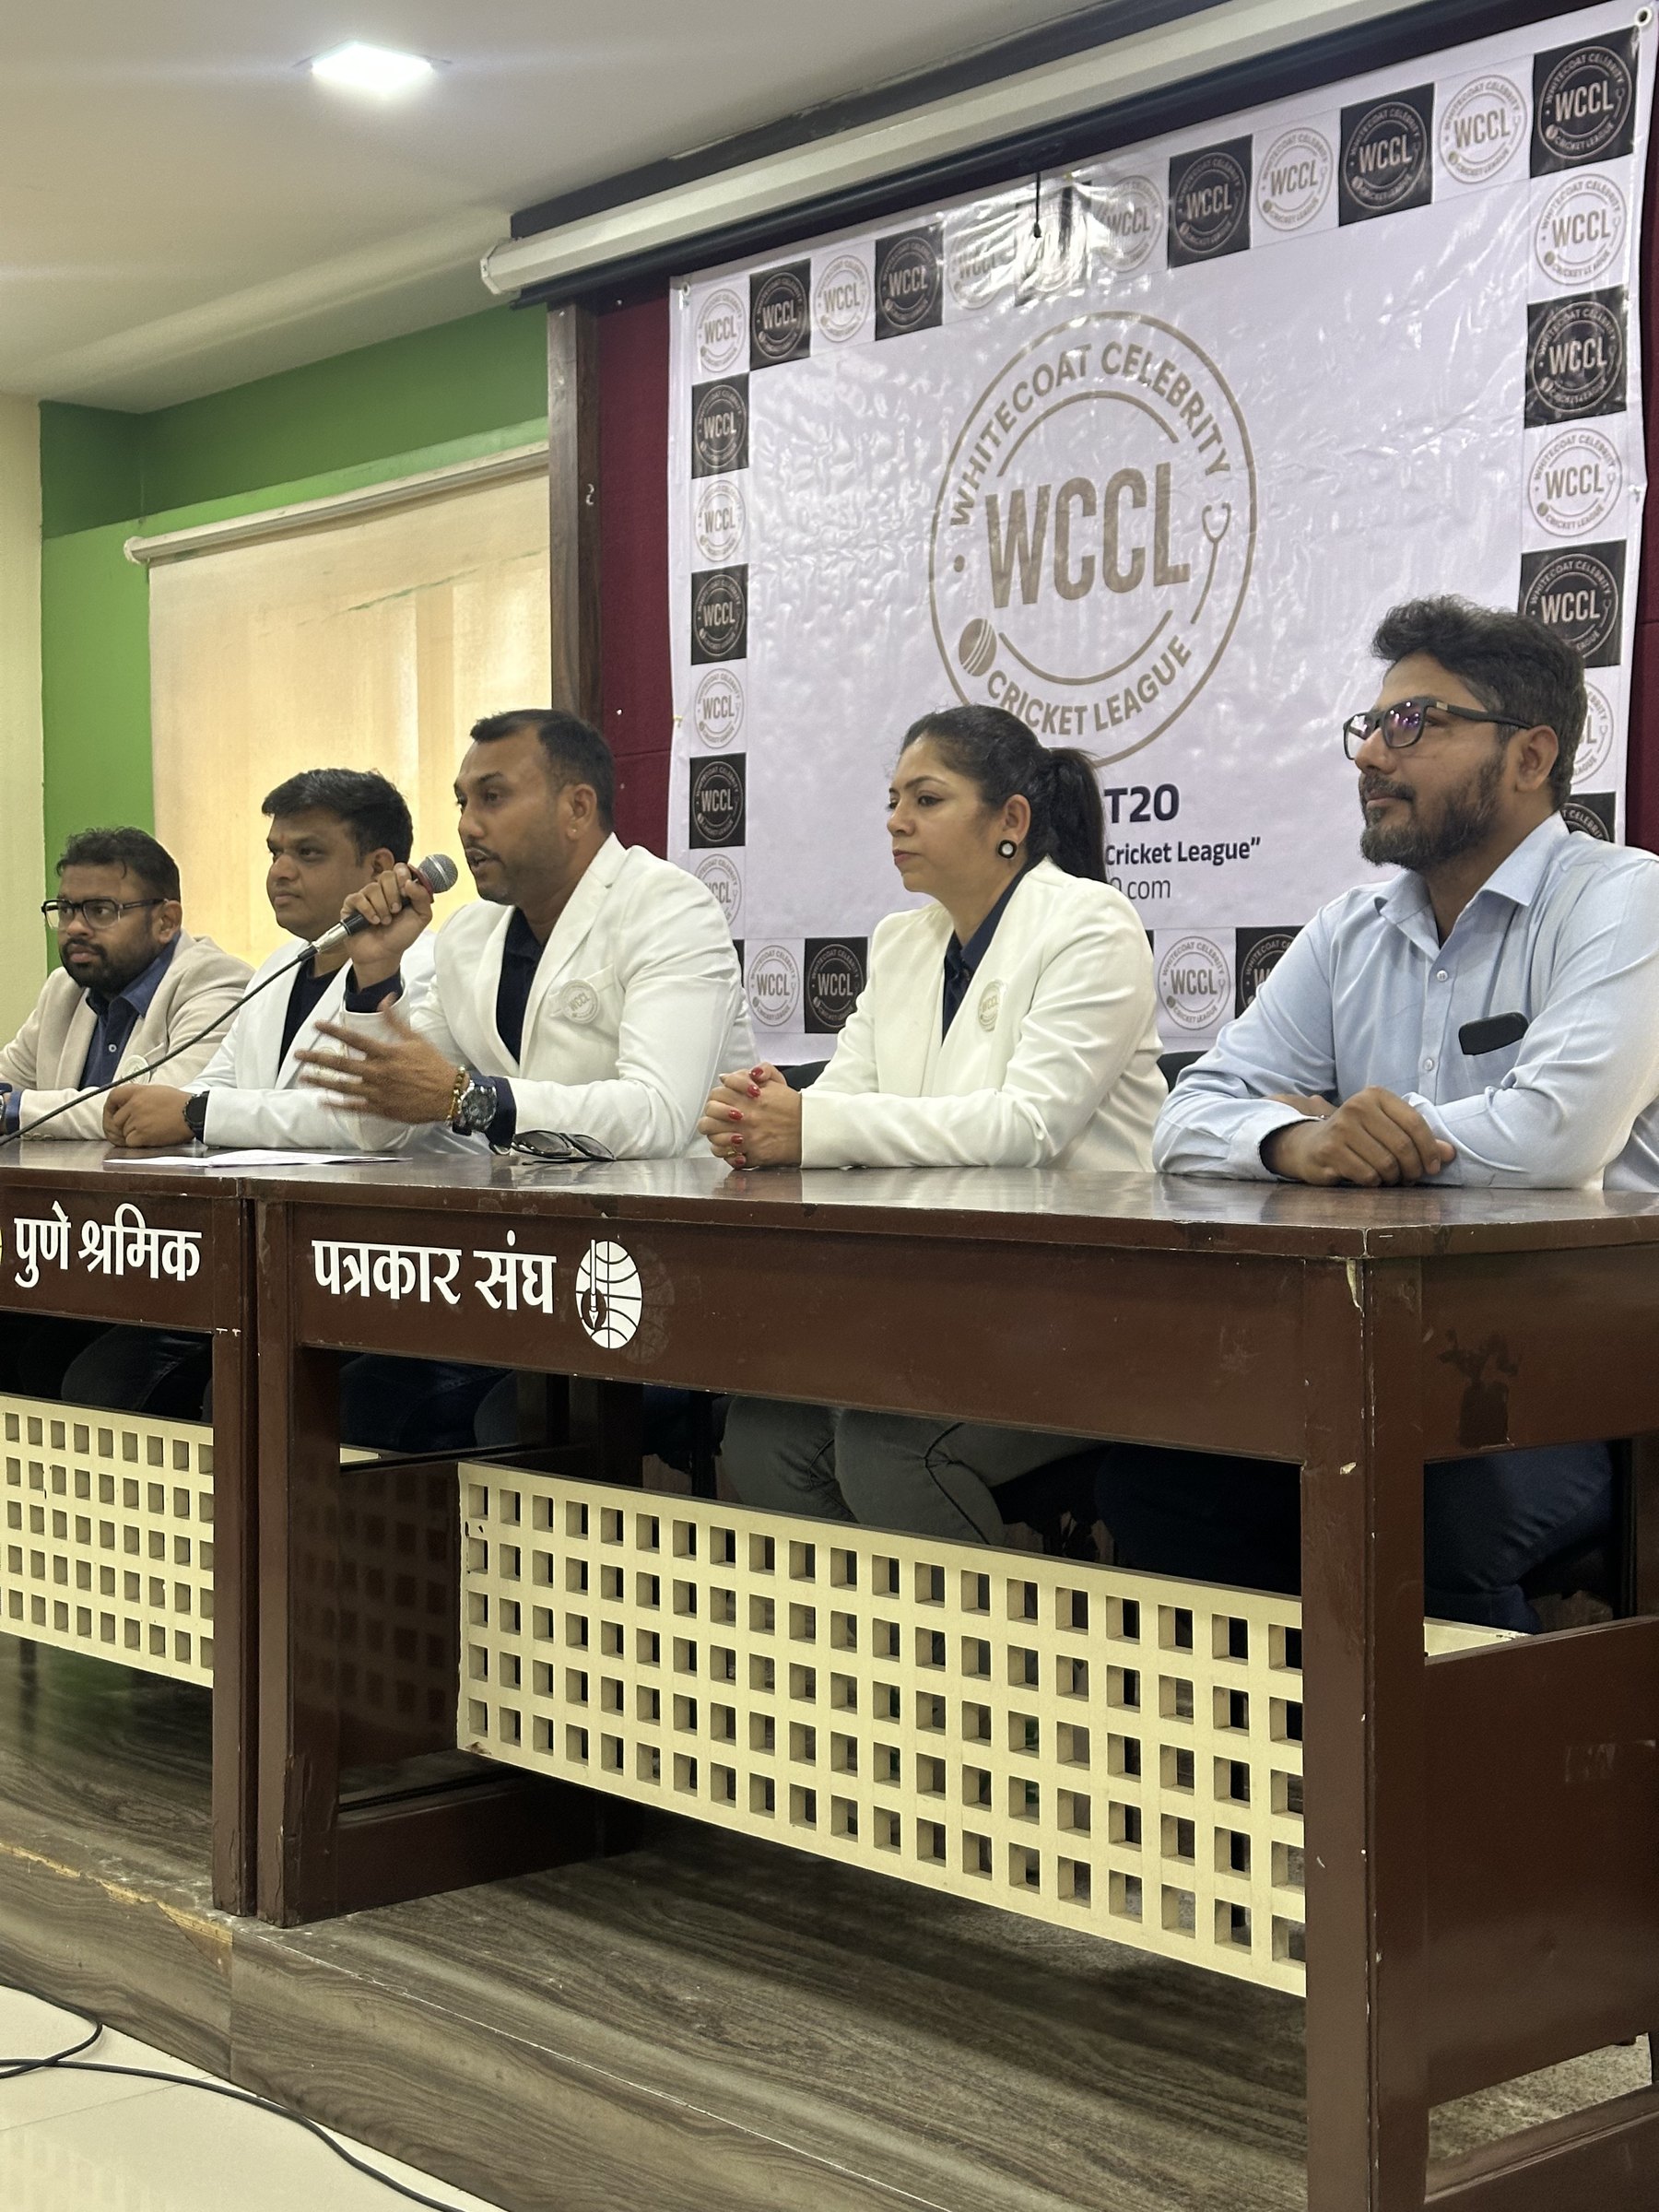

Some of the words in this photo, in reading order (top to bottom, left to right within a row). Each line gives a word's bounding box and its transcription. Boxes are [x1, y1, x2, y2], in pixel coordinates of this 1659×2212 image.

[1555, 80, 1614, 122] WCCL
[1453, 108, 1511, 148] WCCL
[1359, 134, 1413, 174] WCCL
[1270, 159, 1319, 197] WCCL
[1186, 183, 1232, 221] WCCL
[1552, 208, 1611, 249] WCCL
[823, 282, 861, 313] WCCL
[888, 265, 928, 298] WCCL
[704, 315, 737, 345] WCCL
[762, 300, 798, 331] WCCL
[1549, 336, 1607, 375] WCCL
[703, 411, 736, 440] WCCL
[949, 343, 1092, 526] WHITECOAT
[1100, 340, 1232, 477] CELEBRITY
[1534, 434, 1576, 480] WHITECOAT
[1578, 434, 1616, 467] CELEBRITY
[1545, 464, 1605, 500] WCCL
[704, 507, 735, 534] WCCL
[984, 461, 1192, 609] WCCL
[1530, 560, 1573, 605] WHITECOAT
[1576, 559, 1611, 594] CELEBRITY
[703, 601, 735, 627] WCCL
[1541, 590, 1601, 624] WCCL
[987, 669, 1088, 735] CRICKET
[1093, 633, 1193, 734] LEAGUE
[702, 695, 735, 720] WCCL
[701, 788, 734, 812] WCCL
[1104, 783, 1180, 824] T20
[1569, 809, 1604, 839] CELEBRIT
[1105, 841, 1172, 865] Cricket
[757, 973, 791, 996] WCCL
[818, 972, 853, 996] WCCL
[1171, 969, 1218, 995] WCCL
[14, 1200, 71, 1288] पुणे
[78, 1203, 202, 1281] श्रमिक
[312, 1240, 462, 1305] पत्रकार
[473, 1229, 557, 1313] संघ
